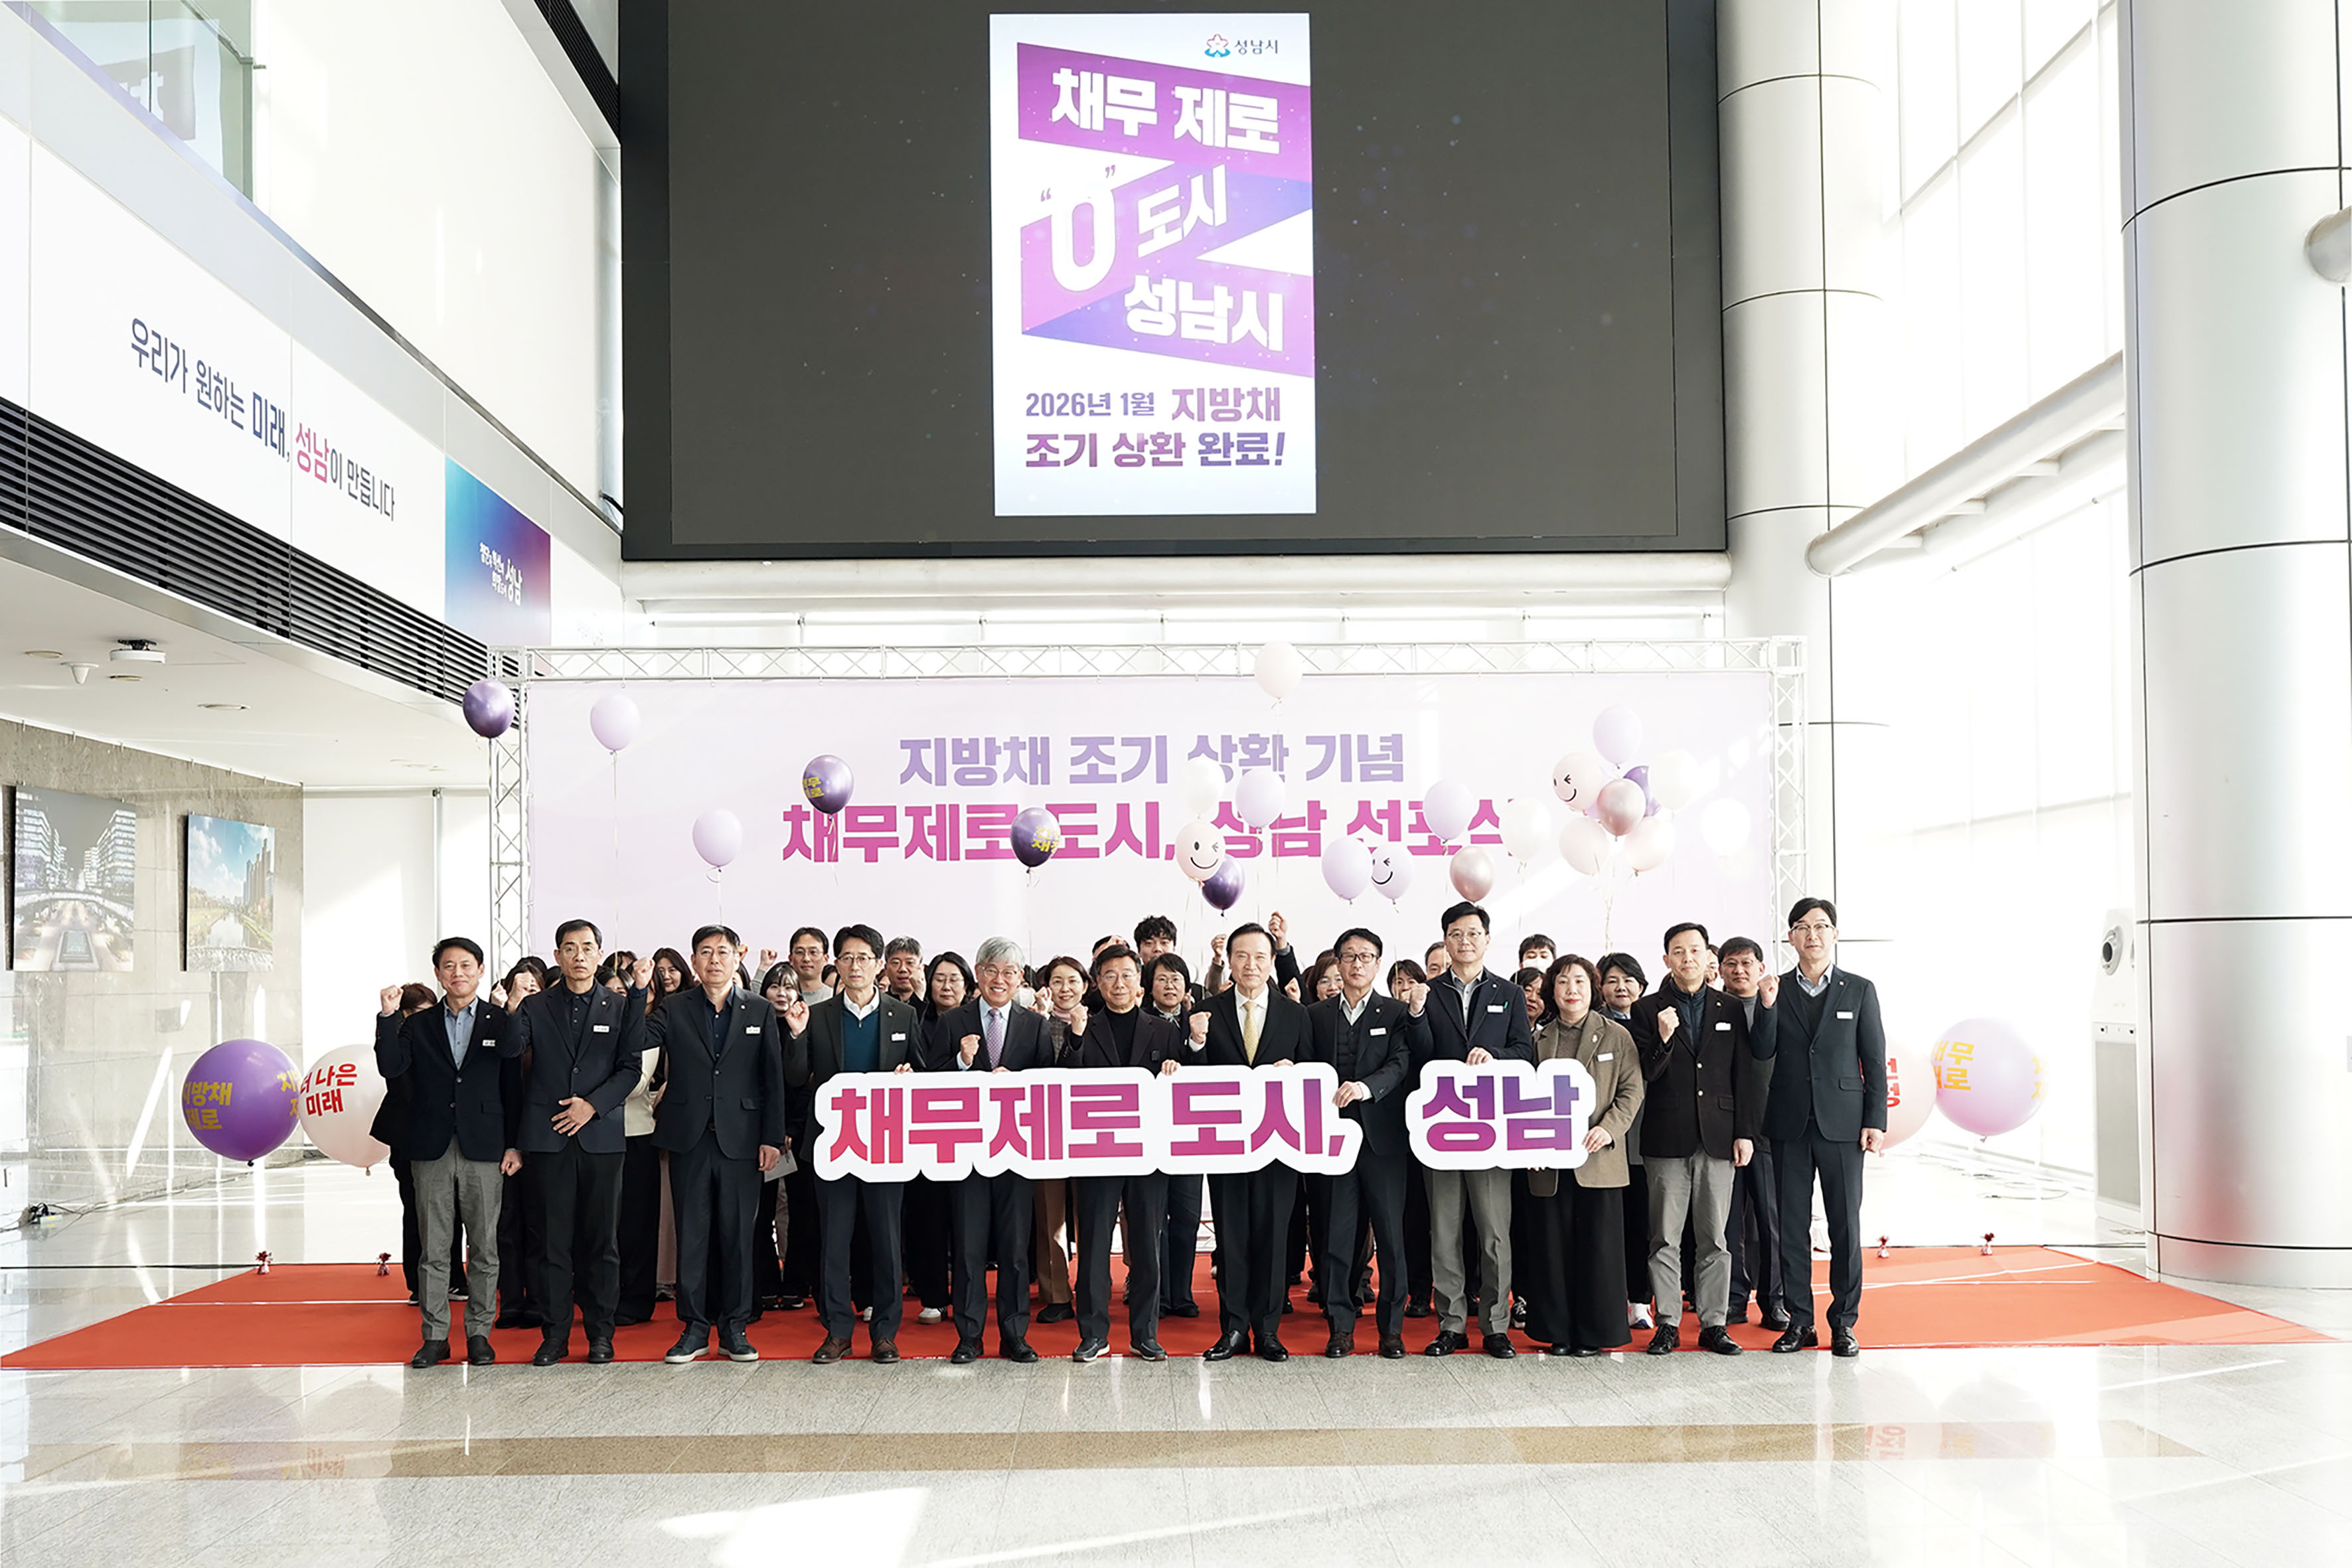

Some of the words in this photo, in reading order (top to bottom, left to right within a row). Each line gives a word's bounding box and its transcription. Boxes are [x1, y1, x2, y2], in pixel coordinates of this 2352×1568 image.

[1234, 39, 1279, 55] 성남시
[1052, 67, 1158, 137] 채무
[1173, 86, 1281, 155] 제로
[1137, 163, 1227, 258] 도시
[1124, 274, 1283, 352] 성남시
[131, 318, 188, 394] 우리가
[196, 360, 244, 430] 원하는
[253, 392, 290, 463] 미래,
[295, 422, 342, 490] 성남이
[347, 458, 395, 522] 만듭니다
[1026, 392, 1111, 417] 2026년
[1120, 392, 1154, 416] 1월
[1171, 387, 1281, 422] 지방채
[1026, 433, 1097, 467] 조기
[1112, 432, 1186, 467] 상환
[1198, 432, 1286, 466] 완료!
[900, 736, 1050, 786] 지방채
[1069, 735, 1168, 783] 조기
[1188, 734, 1289, 783] 상환
[1306, 734, 1403, 782] 기념
[783, 804, 1020, 862] 채무제로
[305, 1088, 344, 1117] 미래
[315, 1063, 357, 1089] 나은
[830, 1083, 1143, 1164] 채무제로
[1170, 1078, 1345, 1157] 도시,
[1422, 1074, 1579, 1152] 성남
